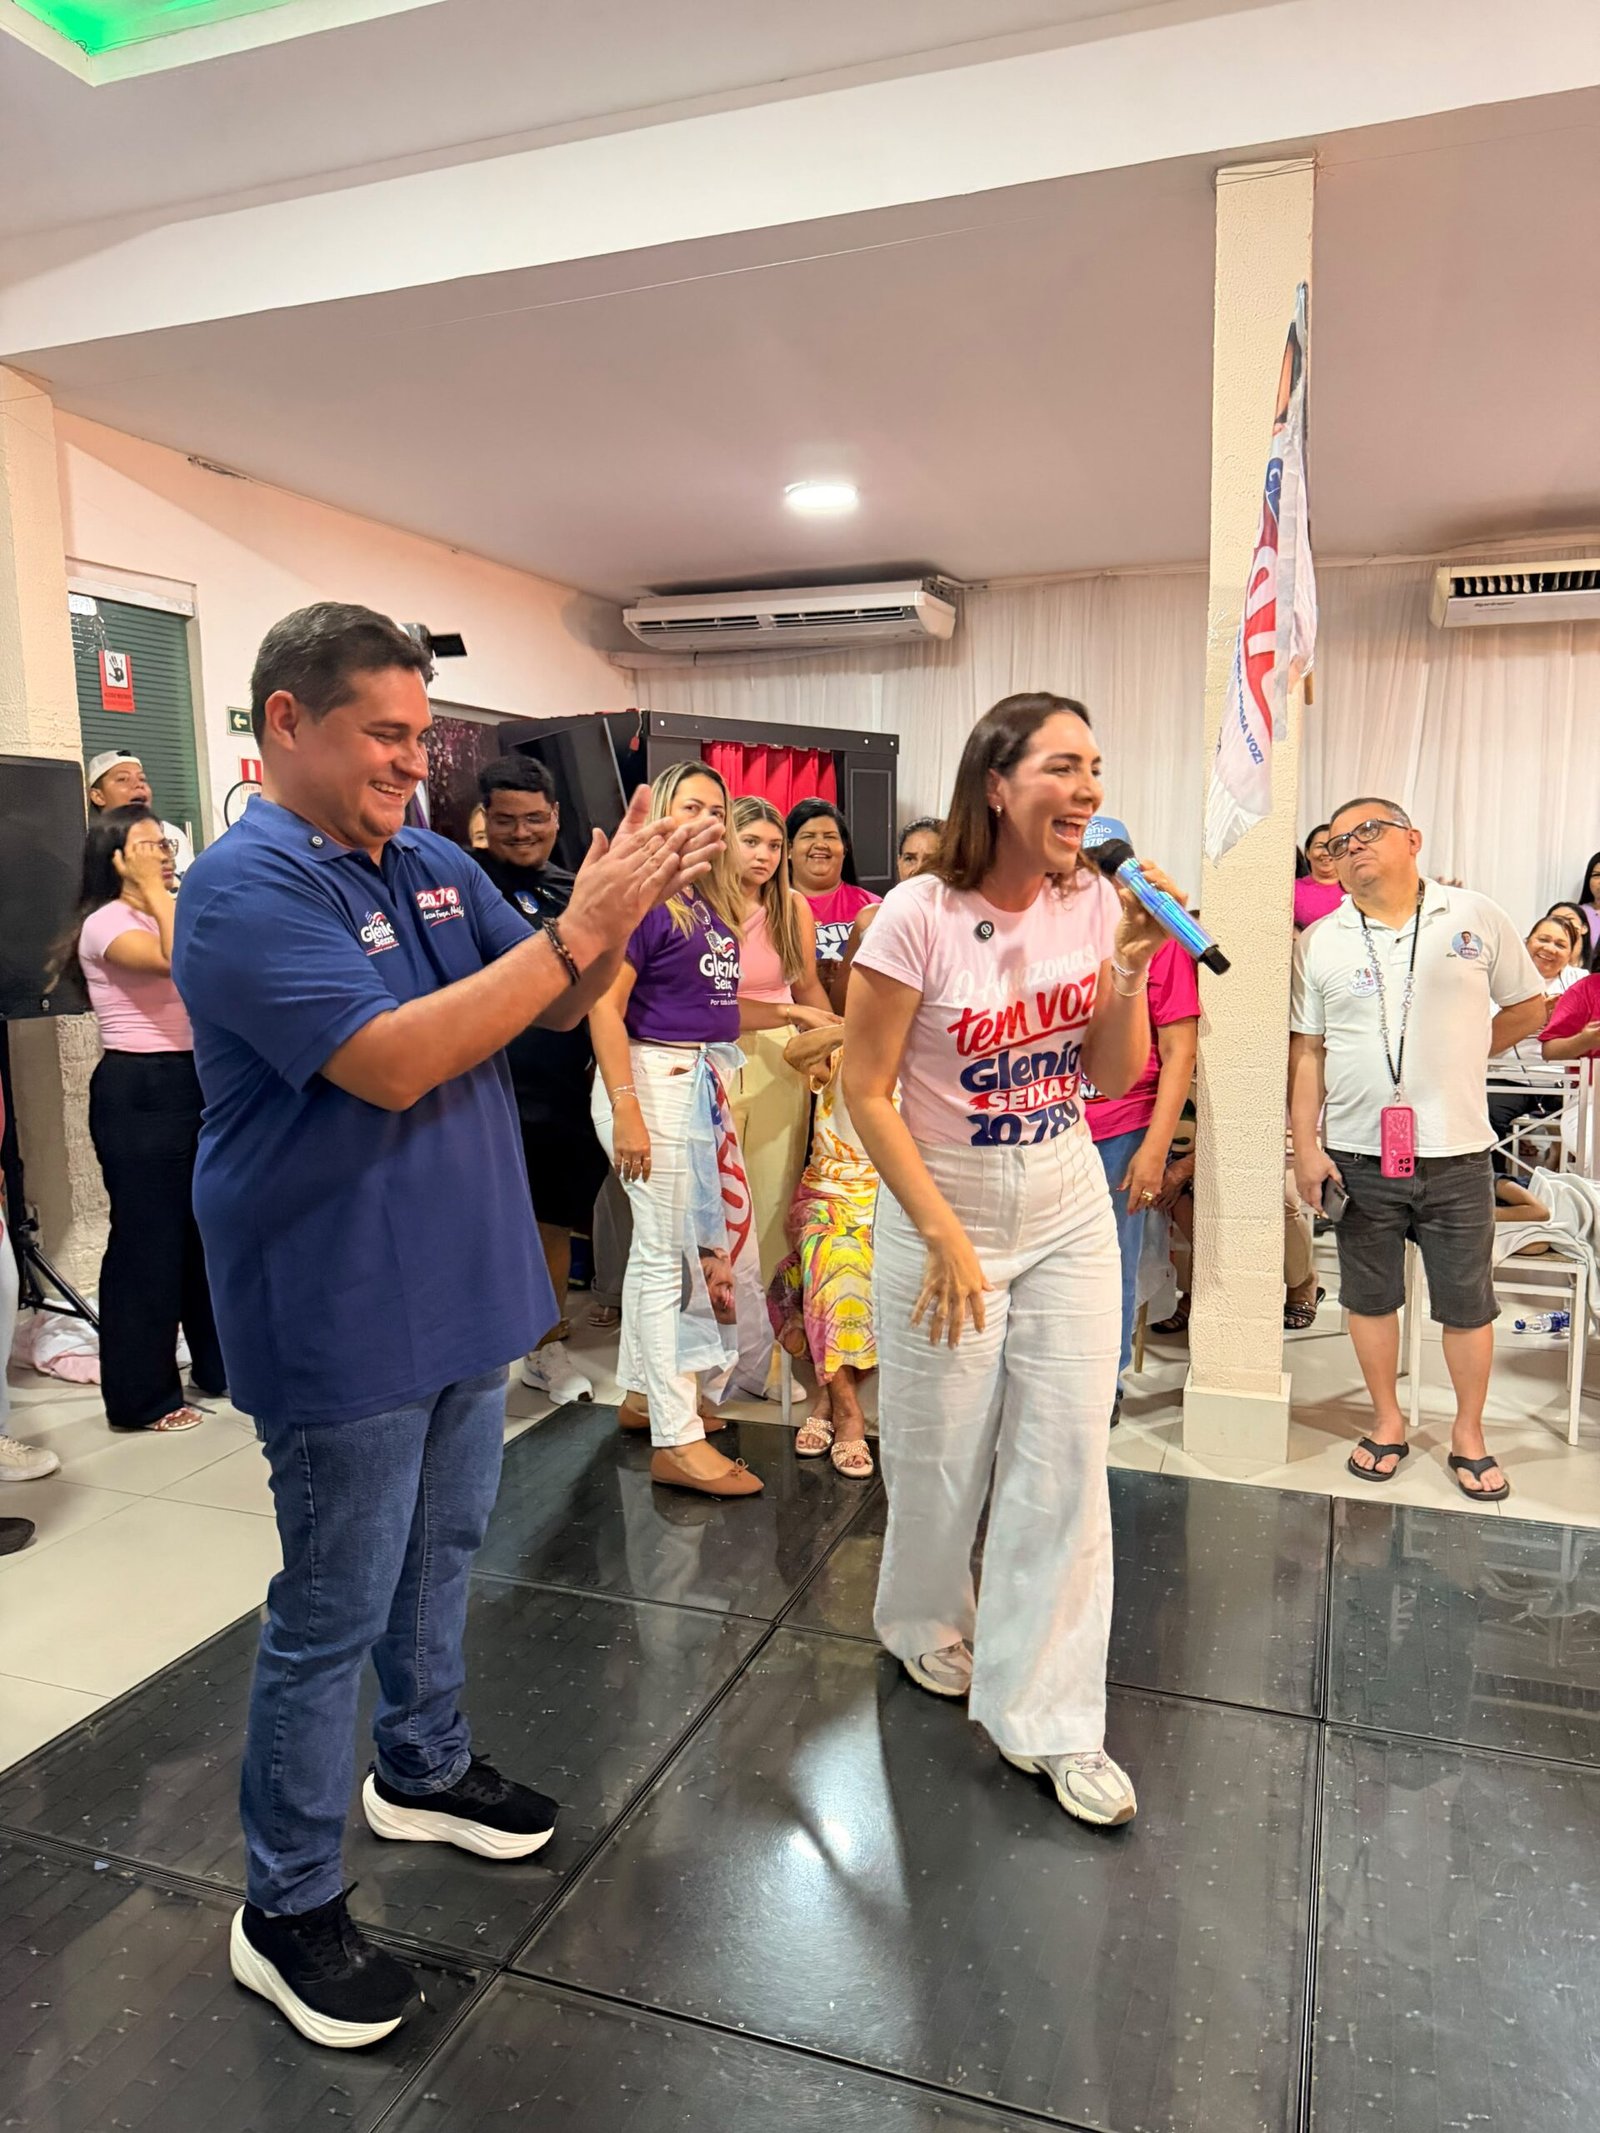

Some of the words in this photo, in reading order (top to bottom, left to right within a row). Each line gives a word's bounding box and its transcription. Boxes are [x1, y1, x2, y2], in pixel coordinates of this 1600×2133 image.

[1245, 734, 1265, 765] VOZ!
[960, 1041, 1083, 1093] Glenio
[988, 1076, 1077, 1112] SEIXAS
